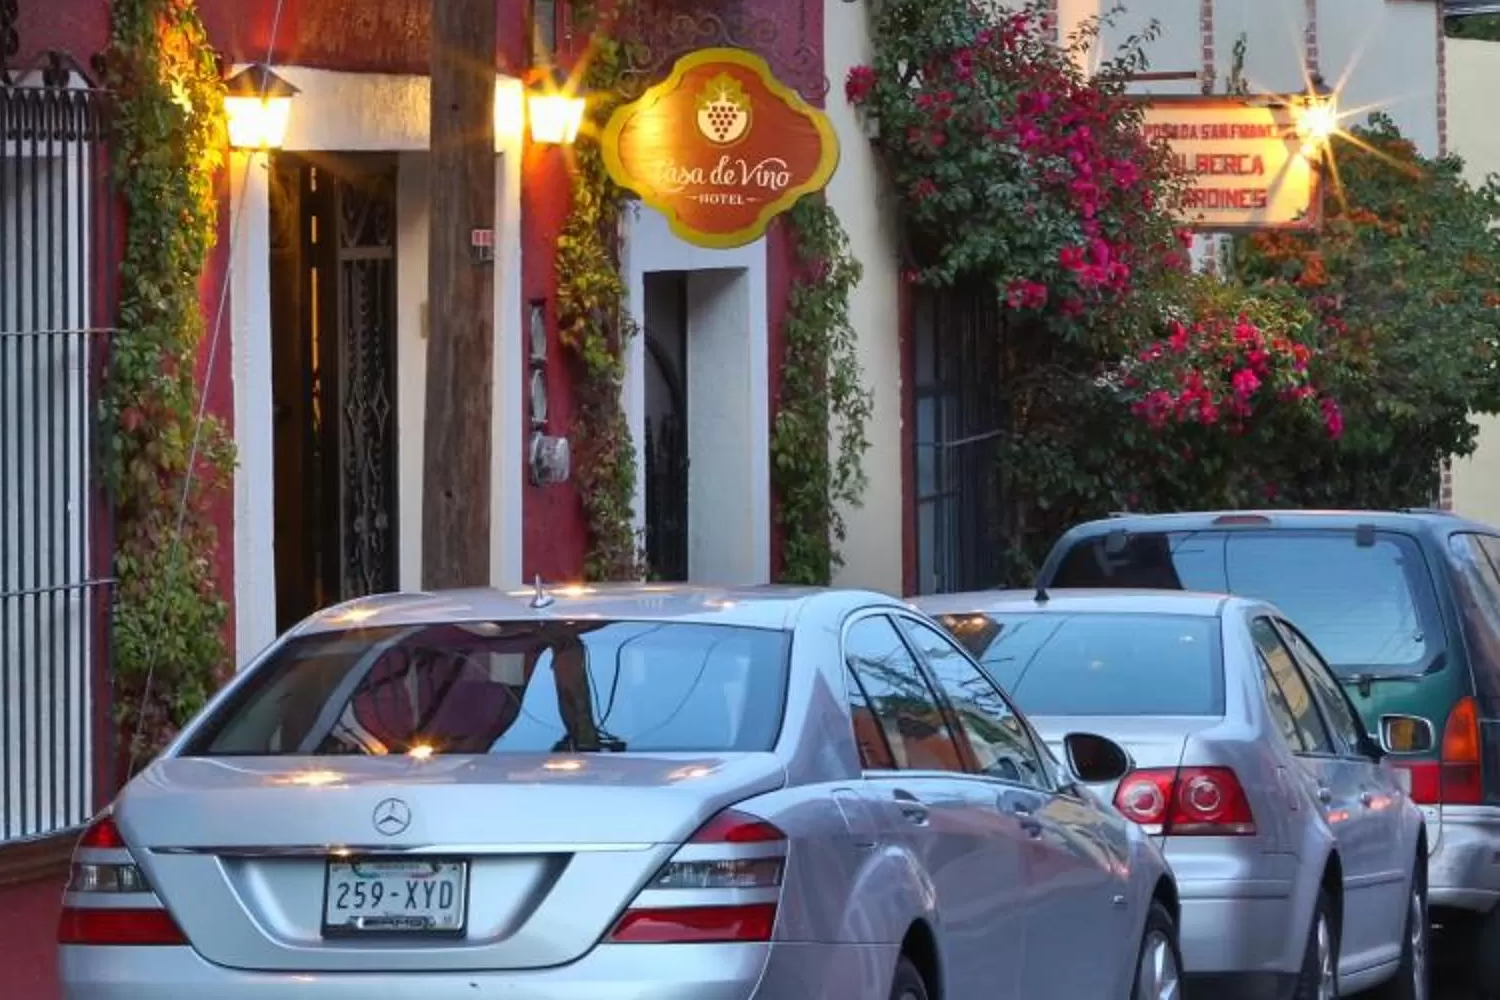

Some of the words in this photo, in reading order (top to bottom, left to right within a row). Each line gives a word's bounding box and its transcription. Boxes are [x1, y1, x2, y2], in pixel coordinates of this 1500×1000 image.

[709, 155, 737, 185] de
[735, 157, 790, 191] Vino
[699, 193, 745, 205] HOTEL
[336, 880, 454, 910] 259-XYD
